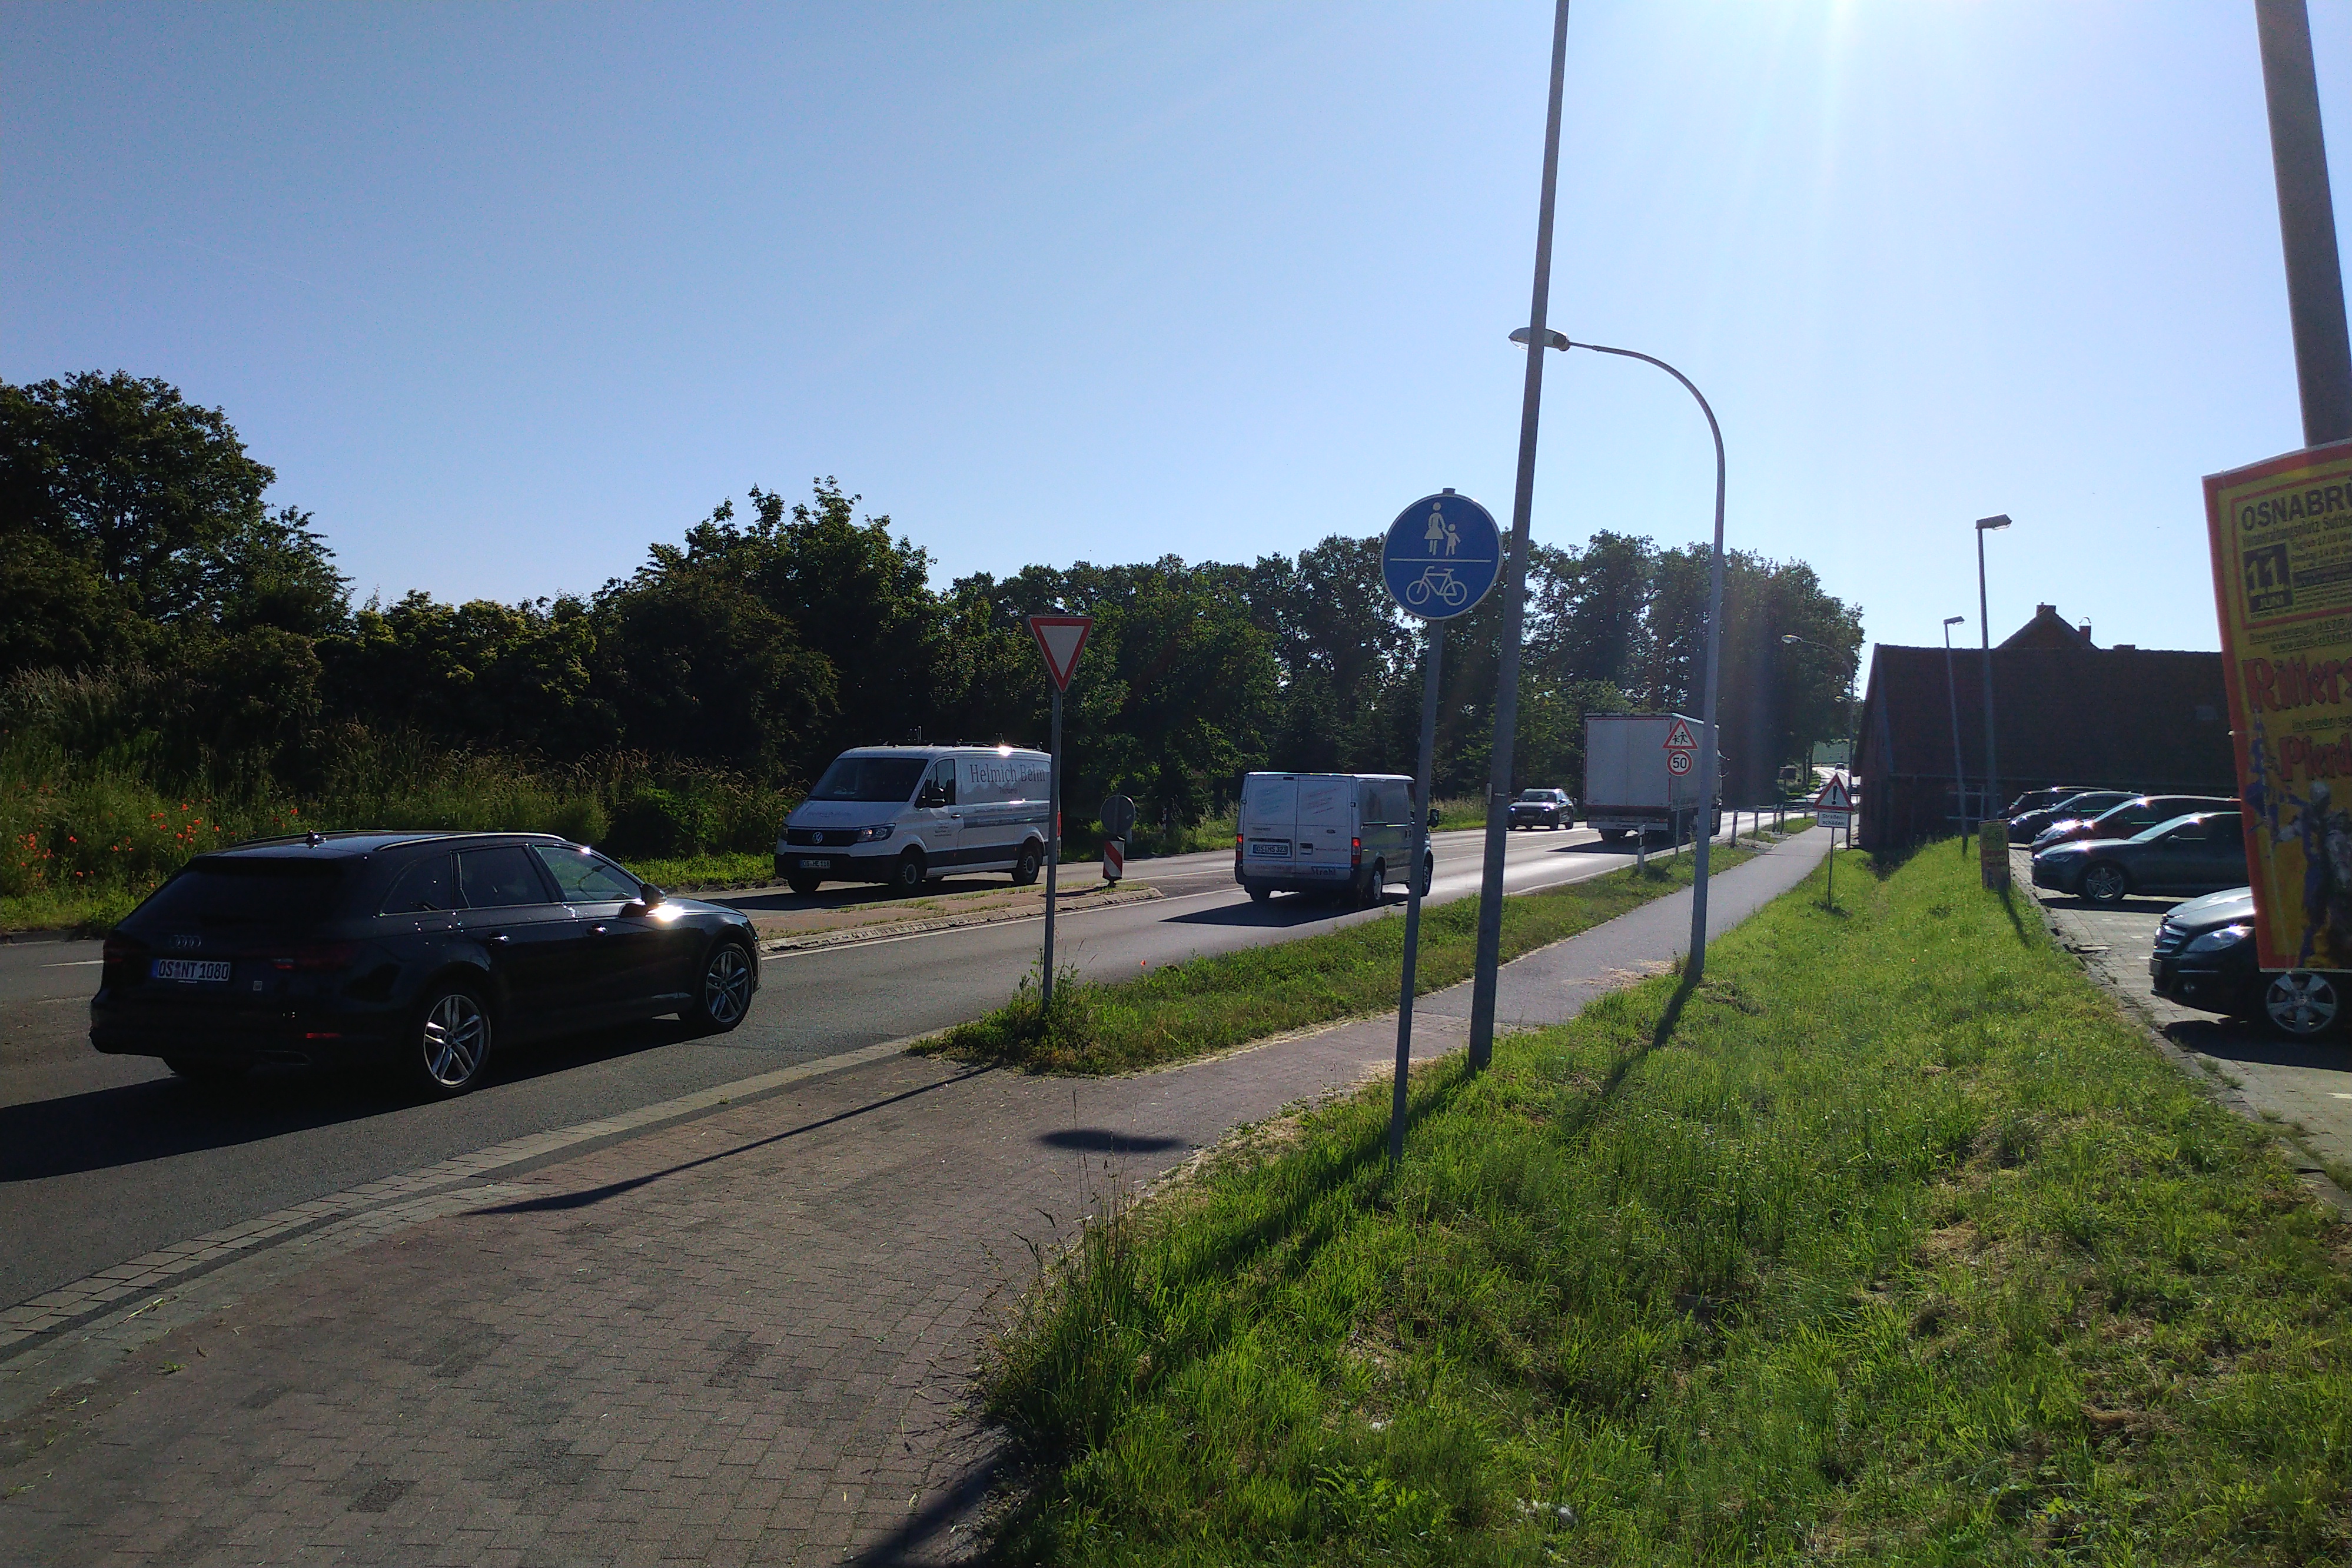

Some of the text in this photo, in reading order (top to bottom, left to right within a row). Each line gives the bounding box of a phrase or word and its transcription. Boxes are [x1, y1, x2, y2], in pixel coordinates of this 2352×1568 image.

[1673, 758, 1687, 769] 50
[969, 763, 1045, 783] Helmich Belm
[158, 961, 229, 979] OS NT 1080
